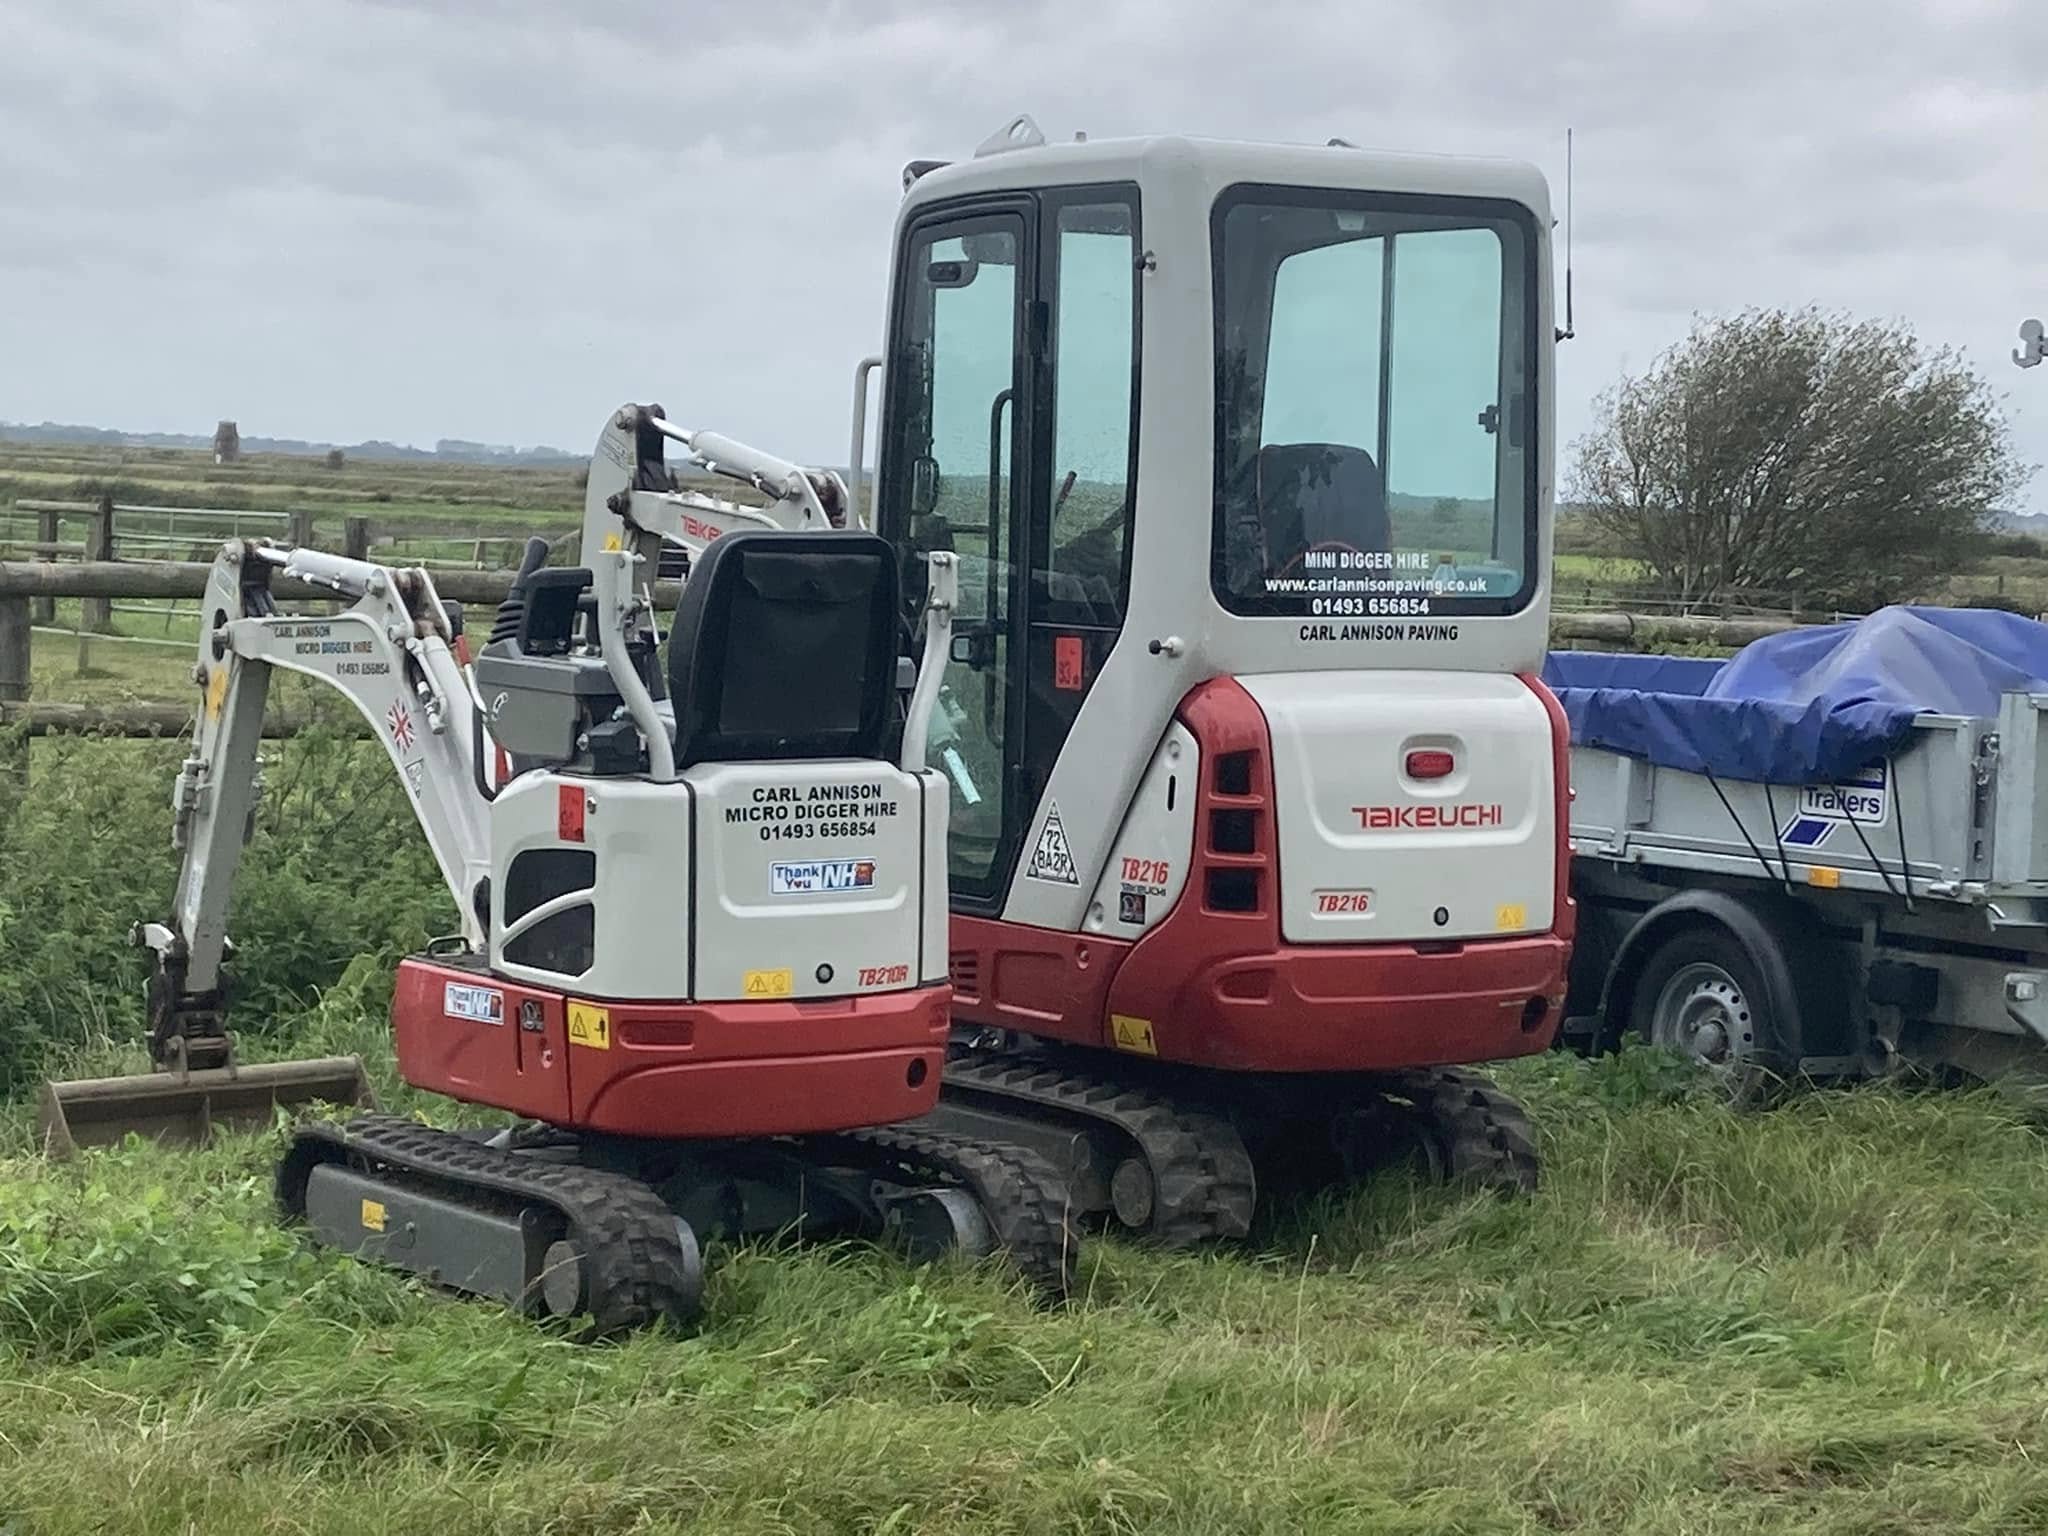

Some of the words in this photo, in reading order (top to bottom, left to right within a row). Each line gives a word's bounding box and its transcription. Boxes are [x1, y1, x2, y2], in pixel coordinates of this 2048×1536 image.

[1305, 552, 1336, 569] MINI
[1340, 552, 1393, 569] DIGGER
[1396, 552, 1429, 569] HIRE
[1265, 576, 1487, 595] www.carlannisonpaving.co.uk
[1312, 599, 1363, 615] 01493
[1368, 599, 1430, 615] 656854
[1300, 626, 1336, 641] CARL
[1340, 625, 1403, 641] ANNISON
[1408, 625, 1458, 641] PAVING
[752, 788, 802, 803] CARL
[807, 784, 882, 801] ANNISON
[1804, 786, 1880, 814] Trailers
[725, 805, 788, 823] MICRO
[795, 804, 860, 820] DIGGER
[864, 802, 897, 817] HIRE
[1352, 804, 1502, 829] TAKEUCHI
[760, 824, 814, 840] 01493
[819, 822, 876, 837] 656854
[775, 865, 819, 880] Thank
[1121, 857, 1169, 885] TB216
[1318, 895, 1368, 912] TB216
